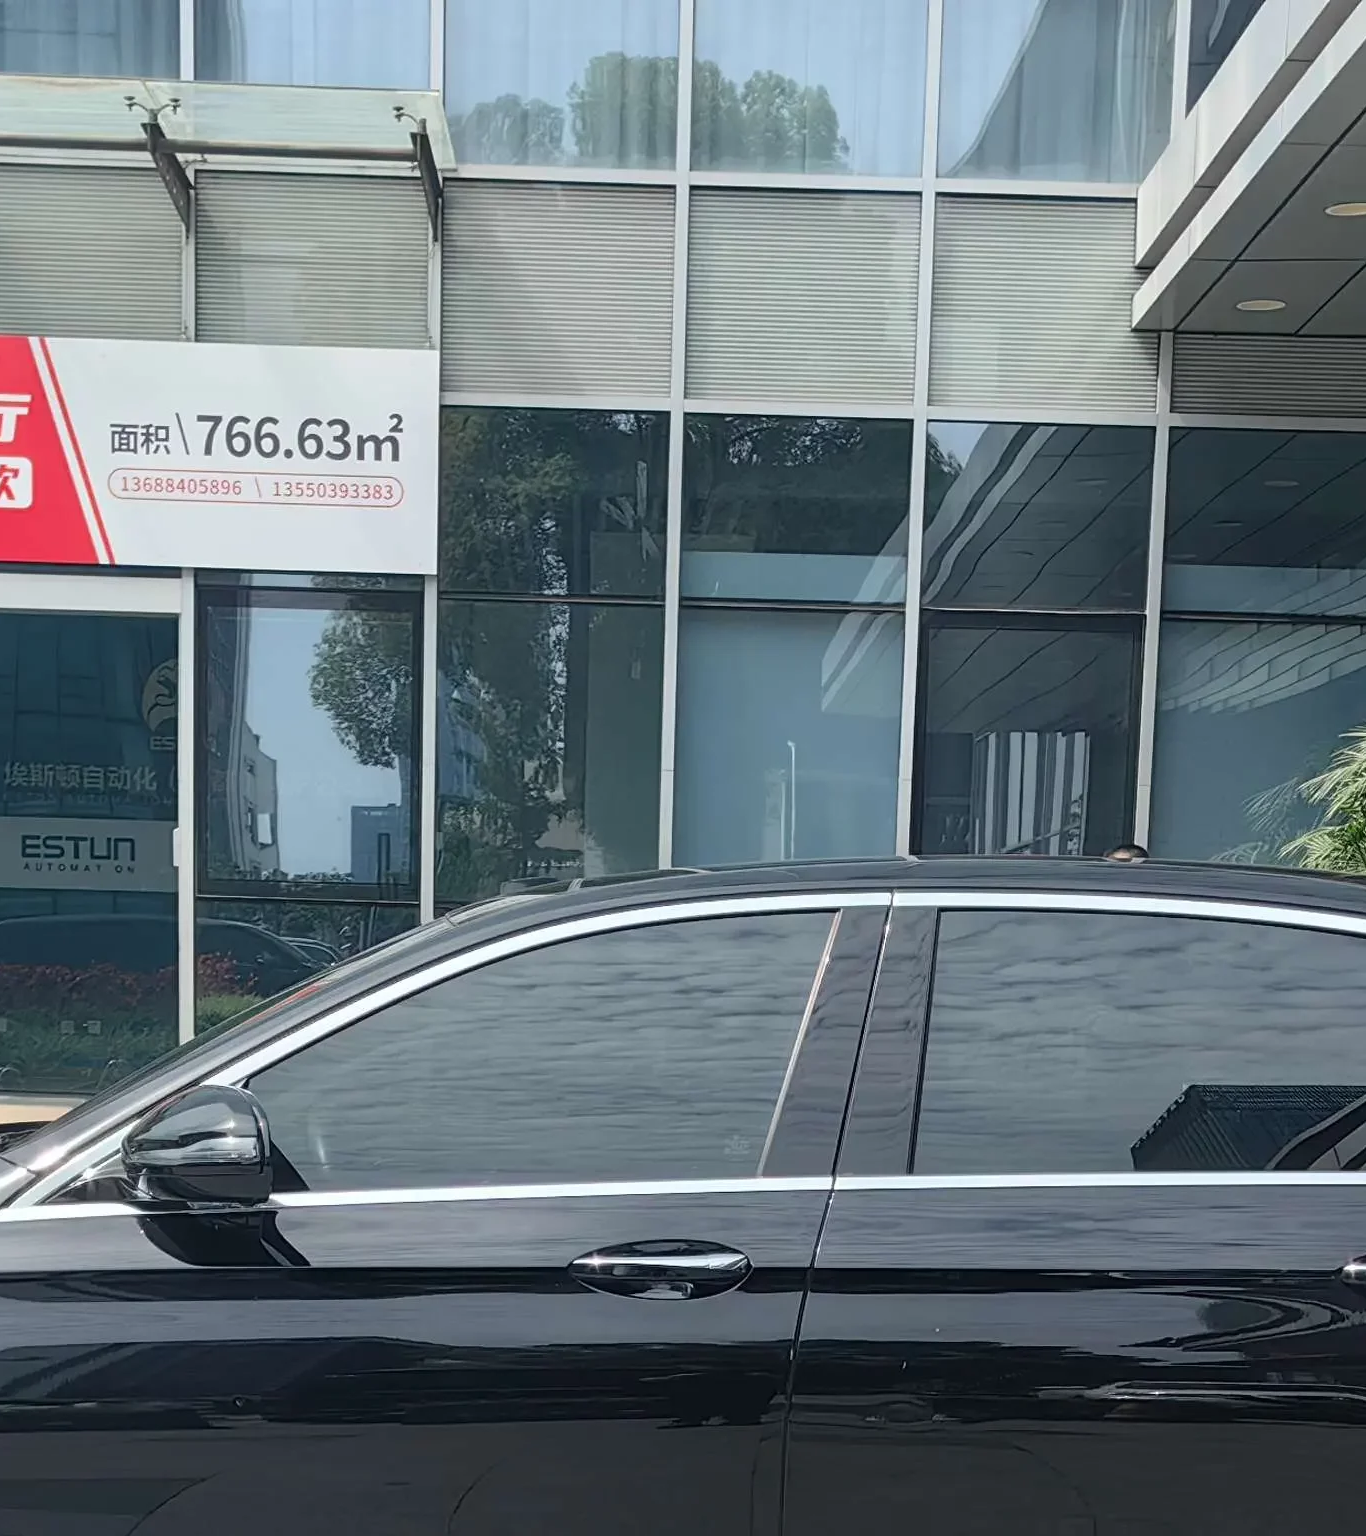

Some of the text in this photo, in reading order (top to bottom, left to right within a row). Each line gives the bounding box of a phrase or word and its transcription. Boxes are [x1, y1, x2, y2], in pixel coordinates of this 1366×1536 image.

[109, 422, 171, 456] 面积
[196, 413, 403, 463] 766.63m²
[121, 476, 243, 497] 13688405896
[272, 481, 394, 501] 13550393383
[21, 834, 136, 862] ESTUN
[23, 862, 136, 874] AUTOMATON
